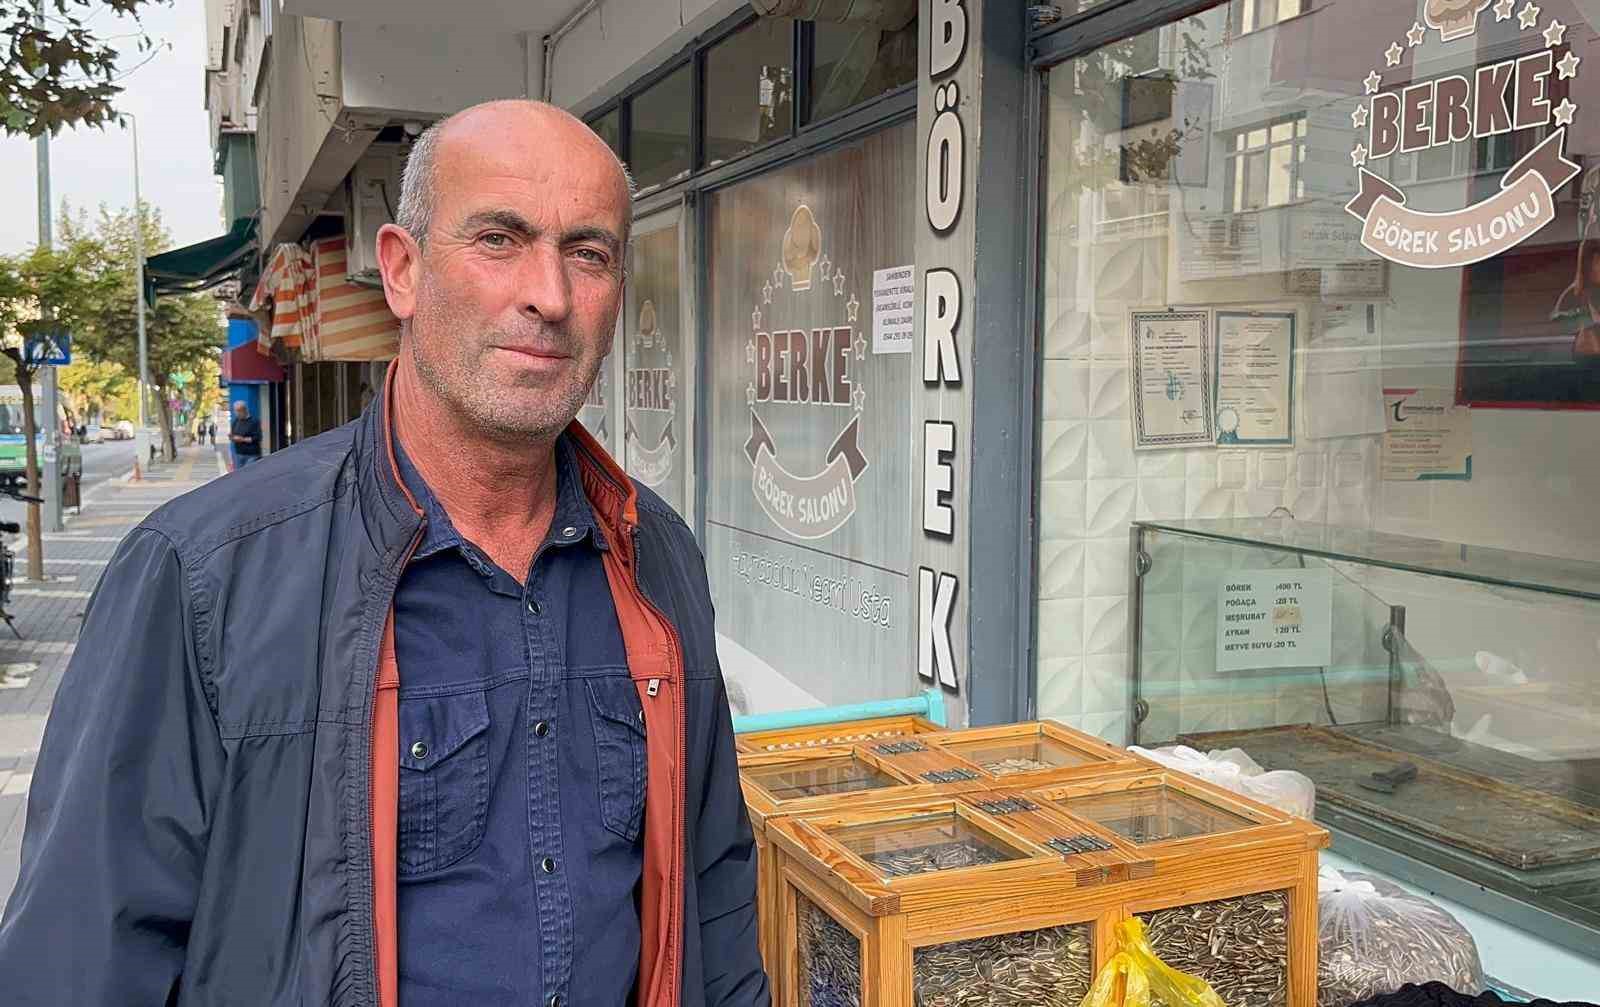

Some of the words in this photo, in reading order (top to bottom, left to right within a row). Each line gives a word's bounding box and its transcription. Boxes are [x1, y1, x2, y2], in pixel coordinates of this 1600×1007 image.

[1369, 50, 1553, 160] BERKE
[1371, 217, 1439, 254] BÖREK
[1447, 192, 1541, 253] SALONU
[755, 326, 852, 406] BERKE
[918, 0, 968, 693] BÖREK
[626, 368, 672, 412] BERKE
[758, 464, 795, 518] BÖREK
[798, 477, 848, 525] SALONU
[849, 576, 895, 628] Usta
[1289, 597, 1298, 605] TL
[1294, 582, 1303, 590] TL
[1287, 640, 1297, 648] TL
[1291, 624, 1302, 633] TL
